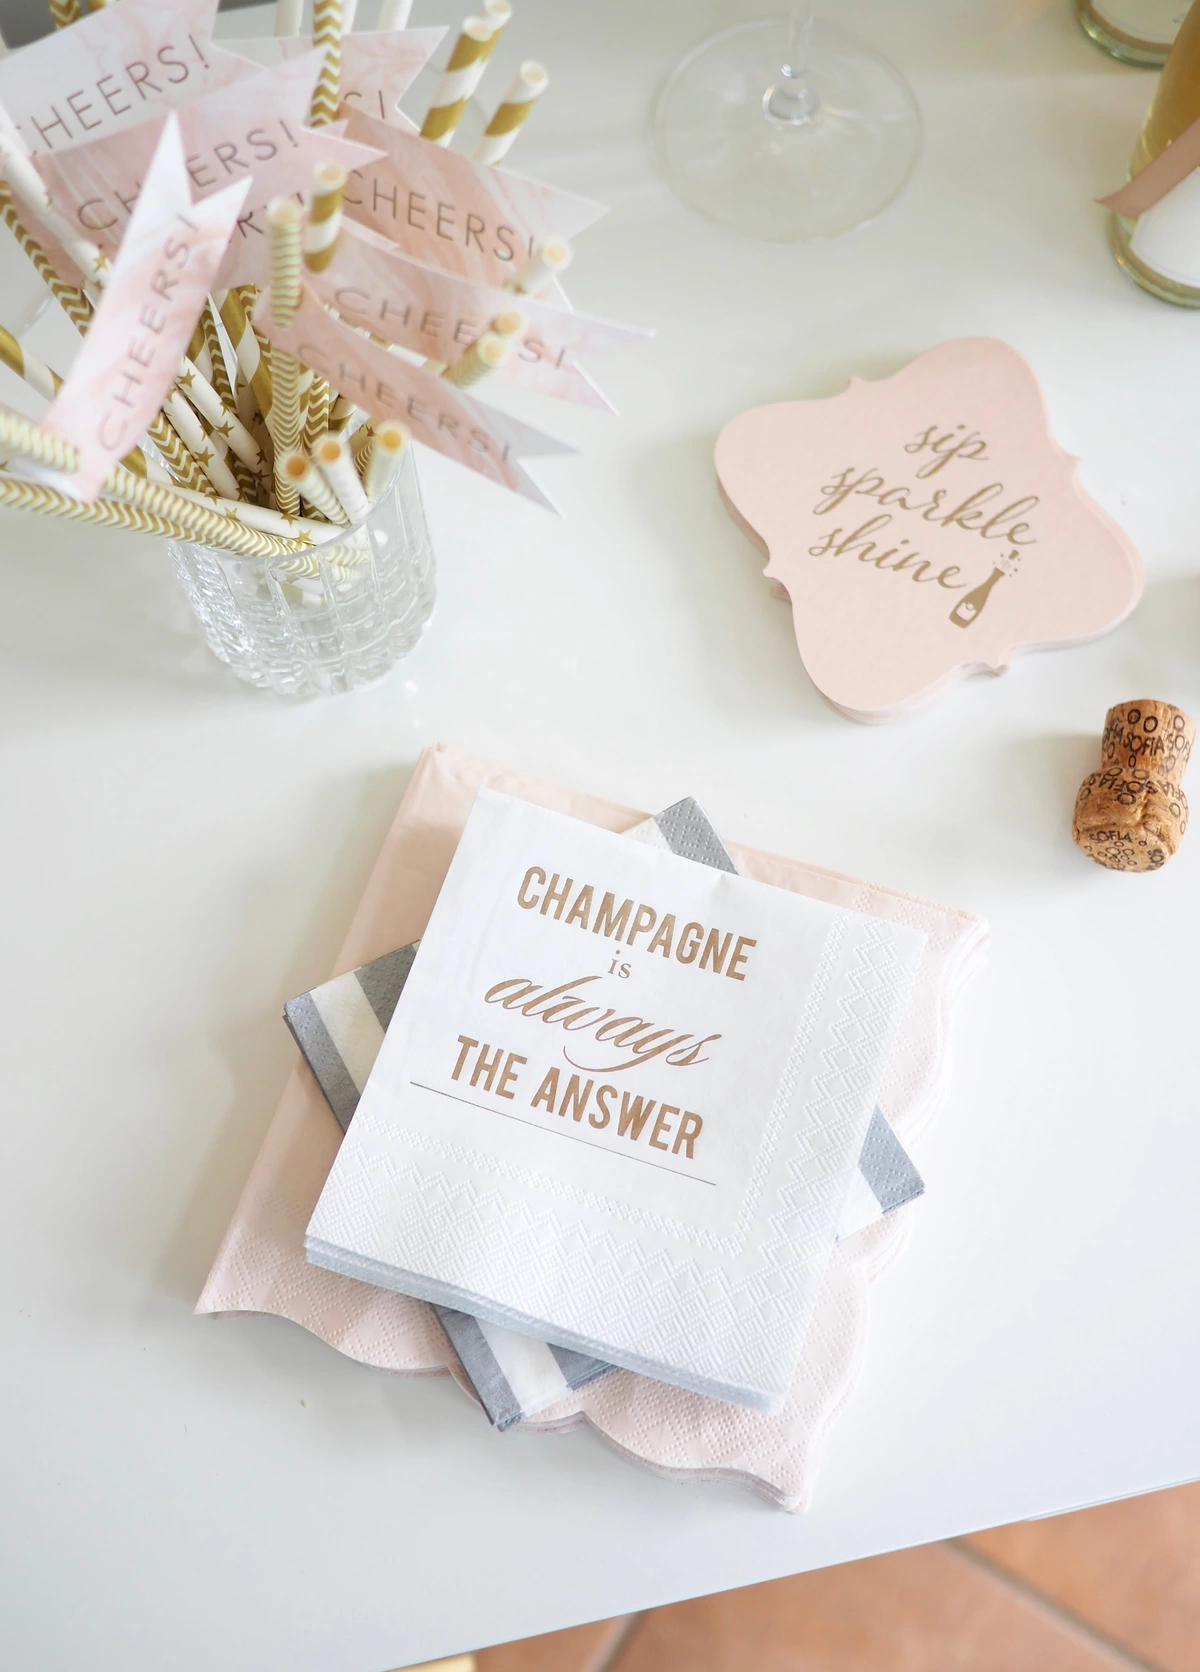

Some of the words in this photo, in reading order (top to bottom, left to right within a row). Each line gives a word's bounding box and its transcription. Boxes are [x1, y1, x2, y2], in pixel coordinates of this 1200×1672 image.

[16, 34, 210, 156] HEERS!
[76, 118, 299, 230] CHERS!
[97, 210, 200, 453] CHEERS!
[333, 285, 567, 371] CHEES!
[298, 342, 511, 464] CHEERS!
[903, 423, 990, 480] sip
[807, 513, 967, 589] shine
[812, 466, 1040, 546] sparkle
[516, 865, 758, 982] CHAMPAGNE
[606, 949, 633, 980] is
[484, 975, 723, 1074] always
[450, 1034, 529, 1101] THE
[529, 1066, 705, 1161] ANSWER
